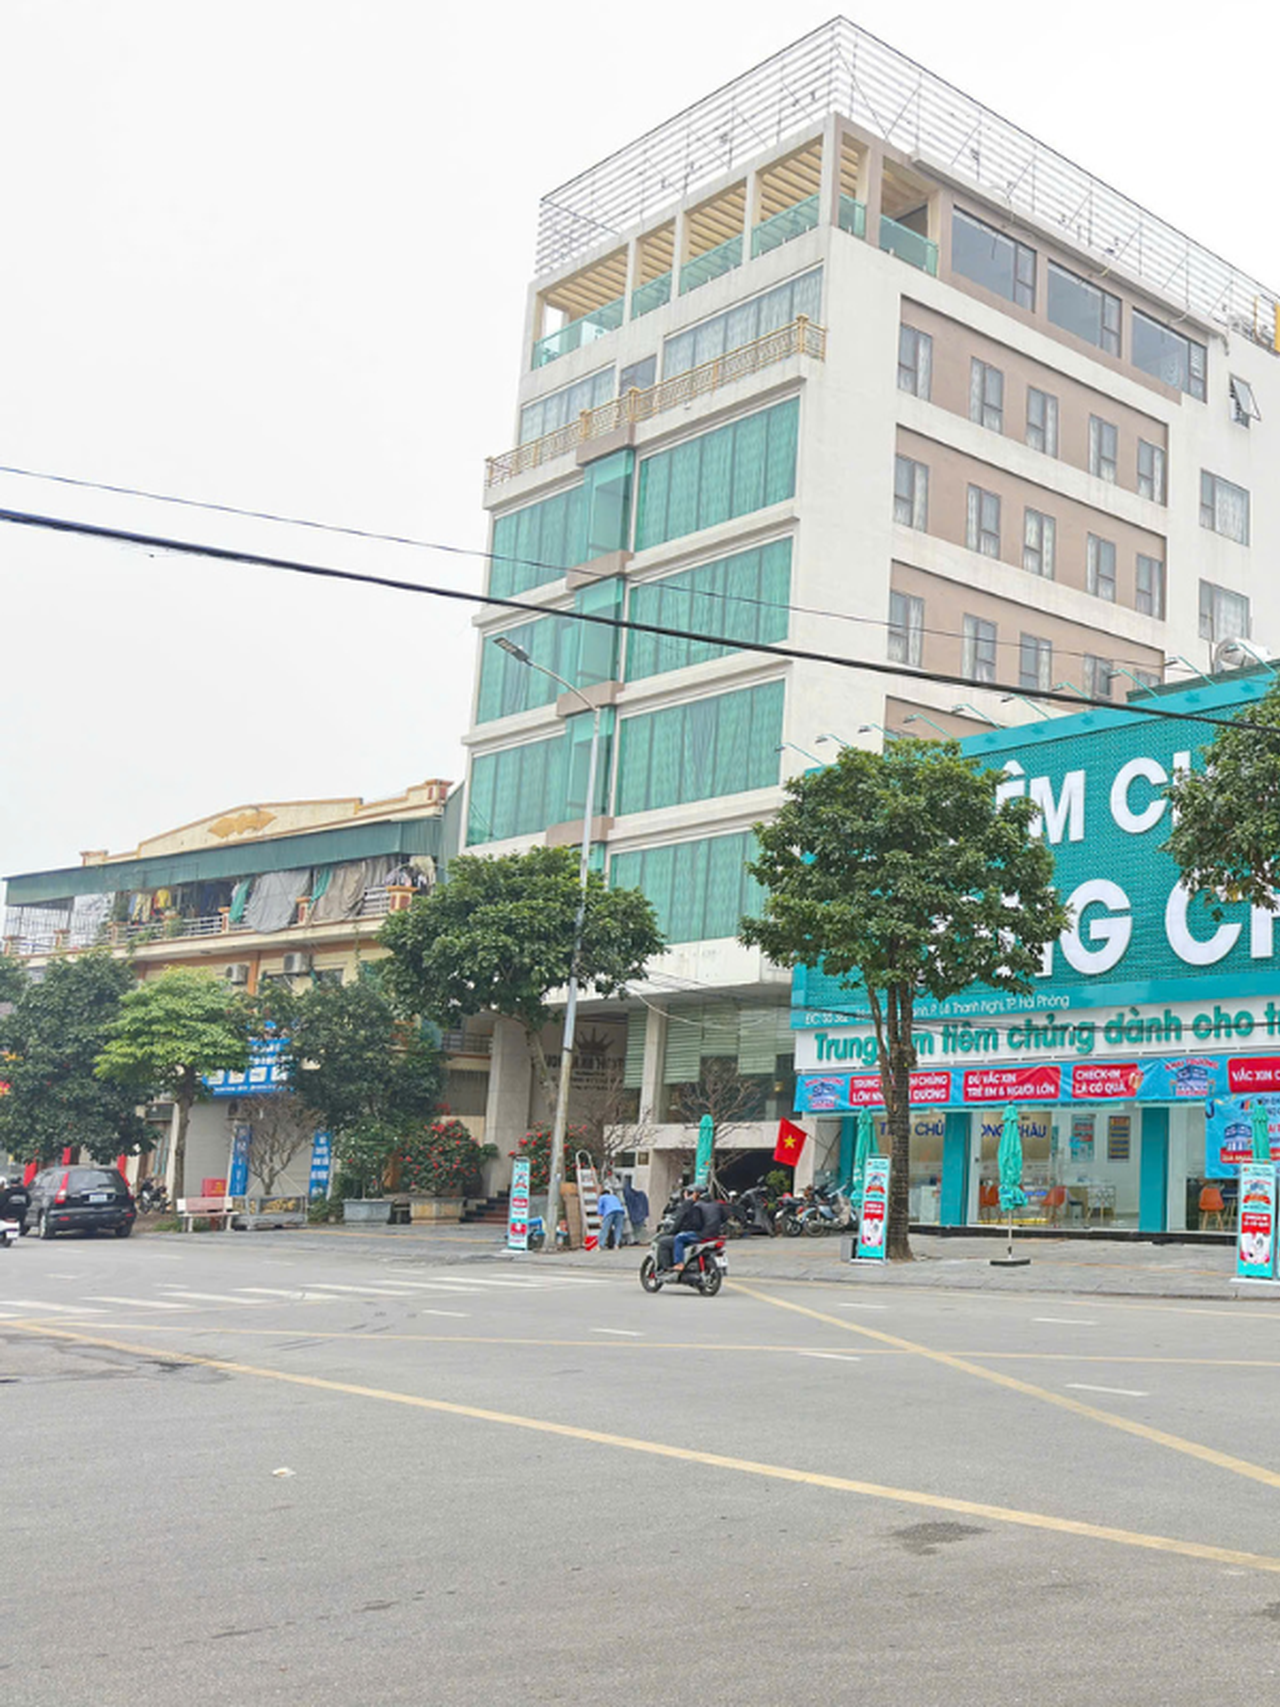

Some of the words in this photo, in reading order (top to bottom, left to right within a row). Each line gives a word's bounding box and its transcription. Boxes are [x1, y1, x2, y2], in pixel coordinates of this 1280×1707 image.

[941, 1020, 999, 1055] tiêm
[1006, 1013, 1095, 1054] chủng
[1104, 1000, 1184, 1045] dành
[1192, 1004, 1255, 1040] cho
[1075, 1067, 1121, 1081] CHECK-IN
[1231, 1066, 1254, 1083] VẮC
[1255, 1068, 1272, 1082] XIN
